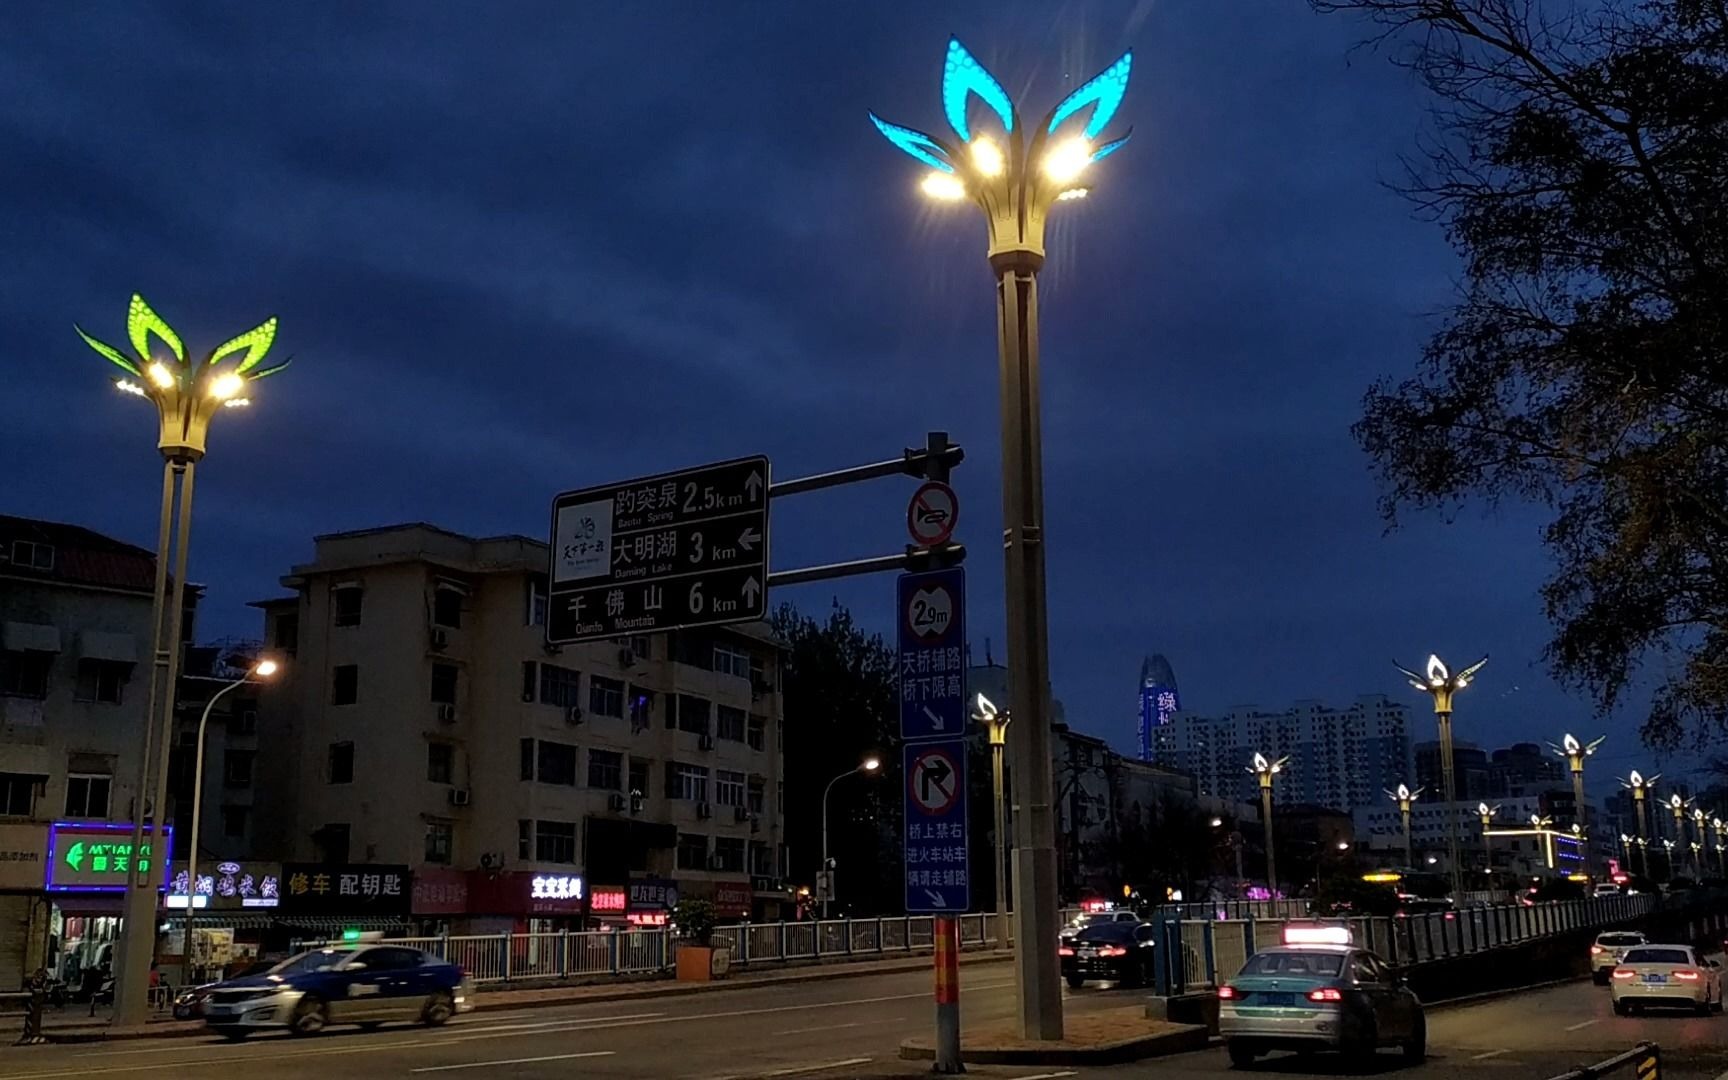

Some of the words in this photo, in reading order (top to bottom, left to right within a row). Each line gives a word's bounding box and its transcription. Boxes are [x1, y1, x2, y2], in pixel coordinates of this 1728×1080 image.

[616, 482, 677, 515] 趵突泉
[683, 482, 715, 513] 2.5
[716, 493, 743, 508] km
[647, 511, 674, 524] Spring
[613, 530, 677, 565] 大明湖
[689, 532, 704, 563] 3
[712, 545, 737, 560] km
[615, 565, 647, 578] Daming
[652, 563, 673, 575] Lake
[689, 581, 704, 614] 6
[713, 597, 737, 612] km
[576, 621, 603, 634] Qianfo
[615, 614, 655, 630] Mountain
[903, 647, 962, 675] 天桥辅路
[903, 673, 962, 702] 桥下限高
[909, 823, 963, 839] 桥上禁右
[906, 846, 966, 863] 进火车站车
[289, 873, 331, 895] 修车
[340, 874, 401, 896] 配钥匙
[908, 870, 967, 887] 辆请走辅路
